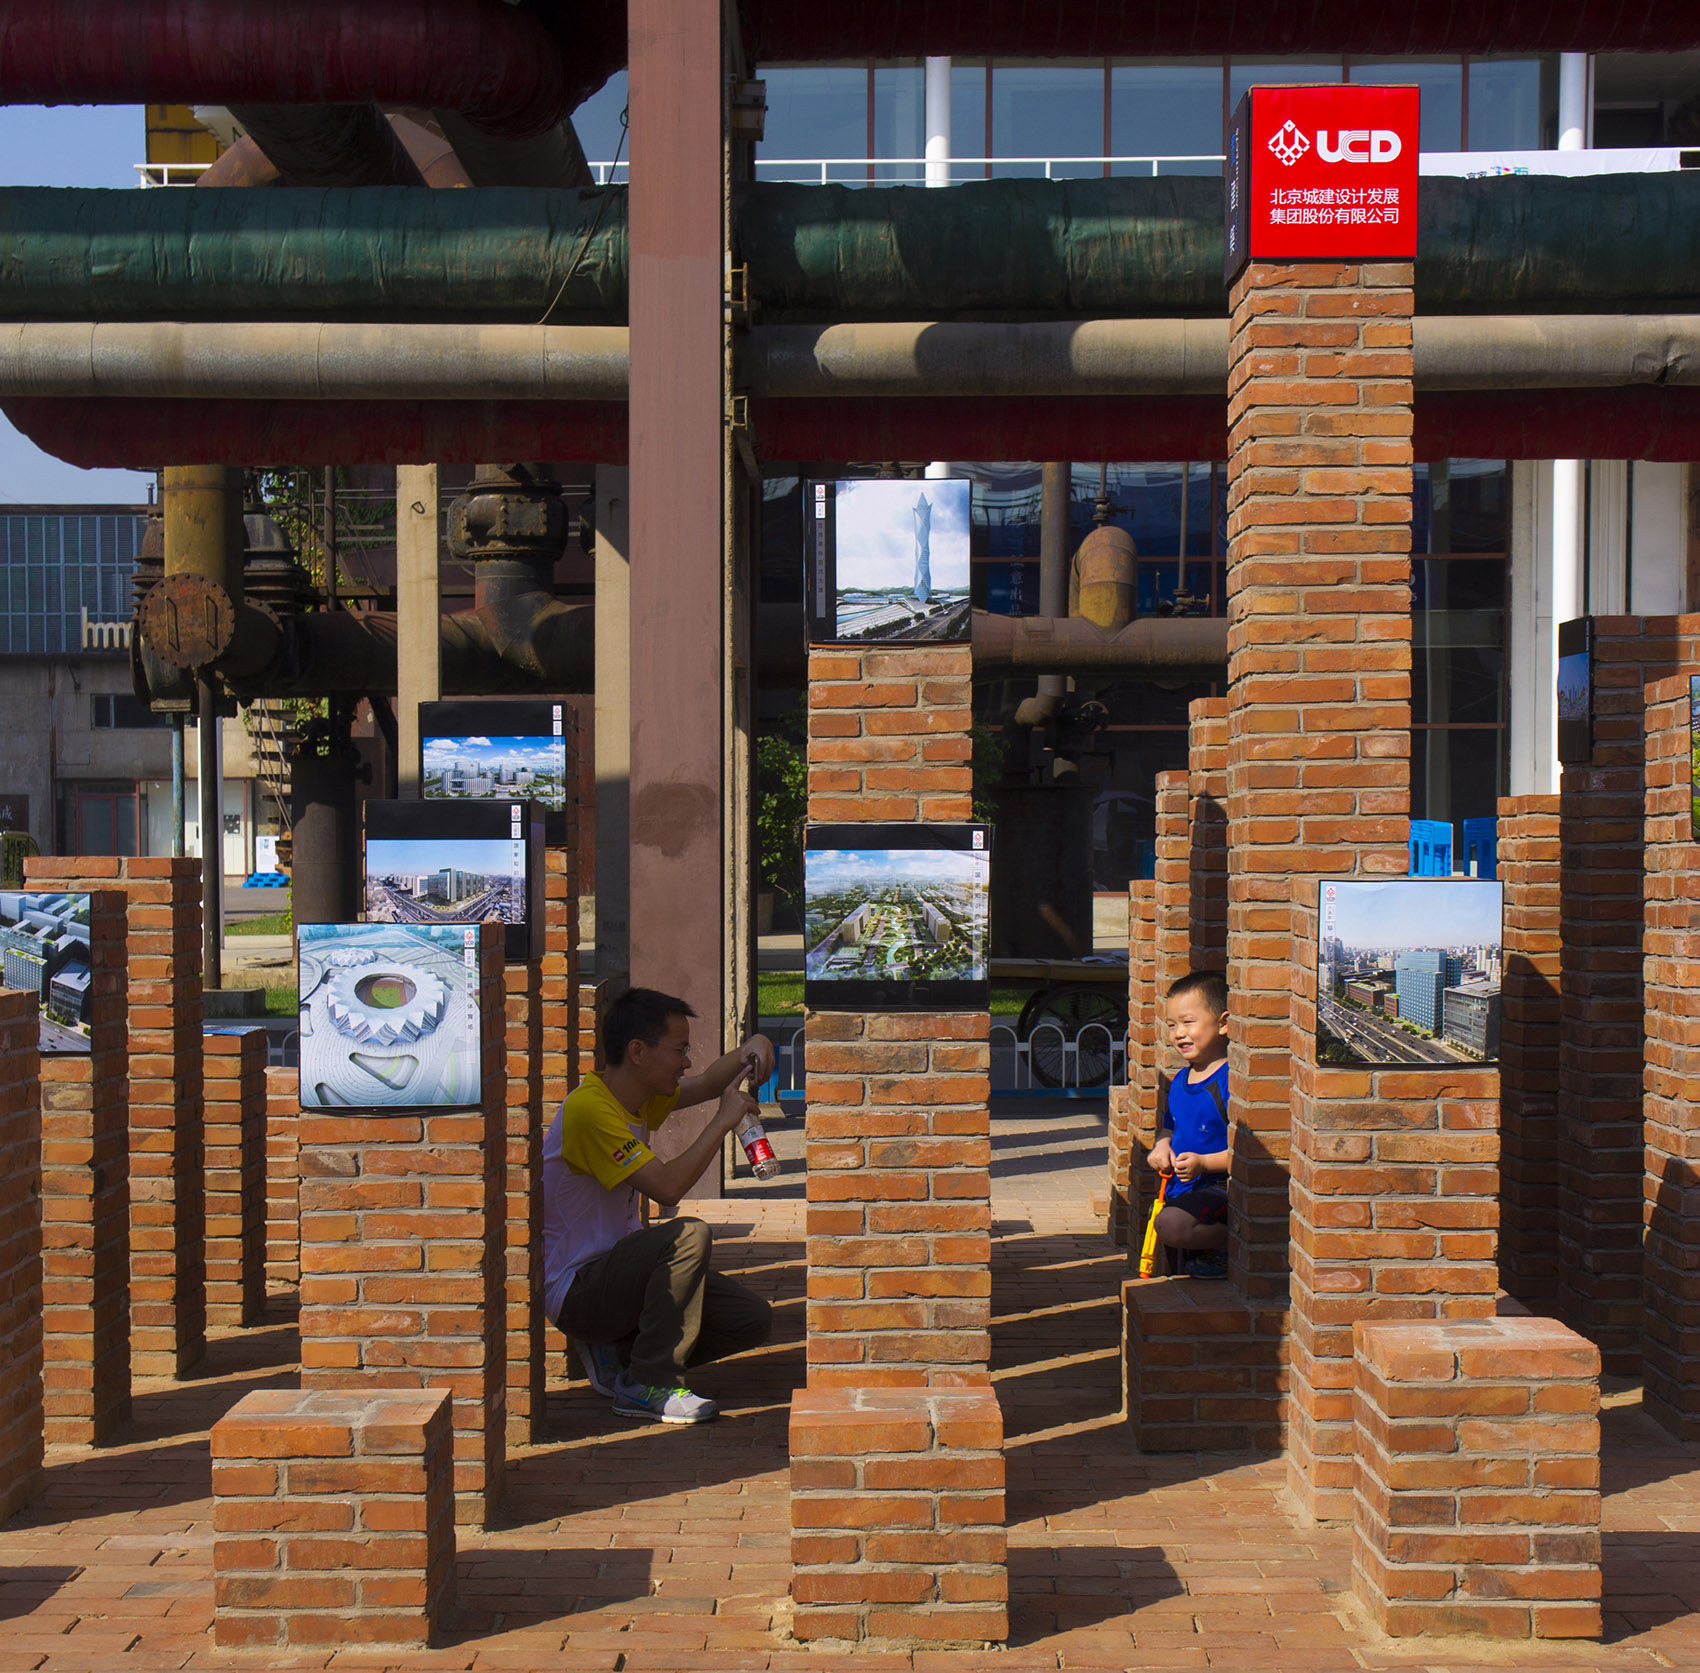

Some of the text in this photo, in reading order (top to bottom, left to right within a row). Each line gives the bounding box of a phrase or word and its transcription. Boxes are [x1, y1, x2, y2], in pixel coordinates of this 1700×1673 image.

[1316, 130, 1402, 163] UCD
[1269, 188, 1400, 206] 北京城建设计发展
[1269, 207, 1400, 225] 集团股份有限公司
